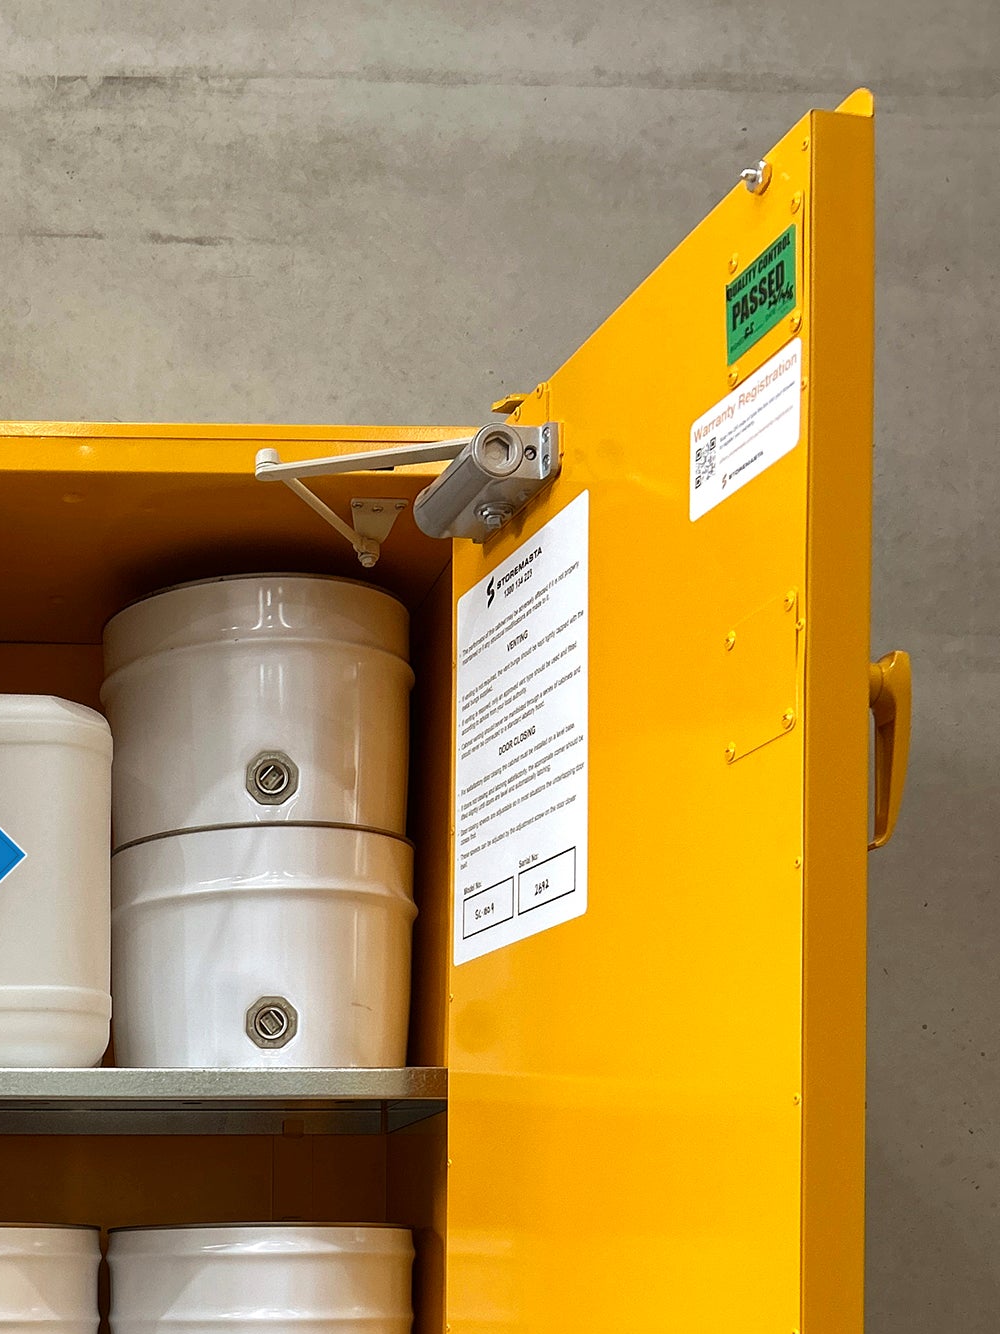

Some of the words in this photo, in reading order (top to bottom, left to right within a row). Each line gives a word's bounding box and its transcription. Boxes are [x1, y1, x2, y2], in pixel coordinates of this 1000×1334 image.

[758, 233, 790, 274] CONTROL
[732, 260, 785, 332] PASSED
[693, 402, 736, 443] Warranty
[738, 353, 798, 409] Registration
[497, 546, 542, 590] STOREMASTA
[507, 630, 528, 652] VENTING
[513, 724, 535, 746] CLOSING
